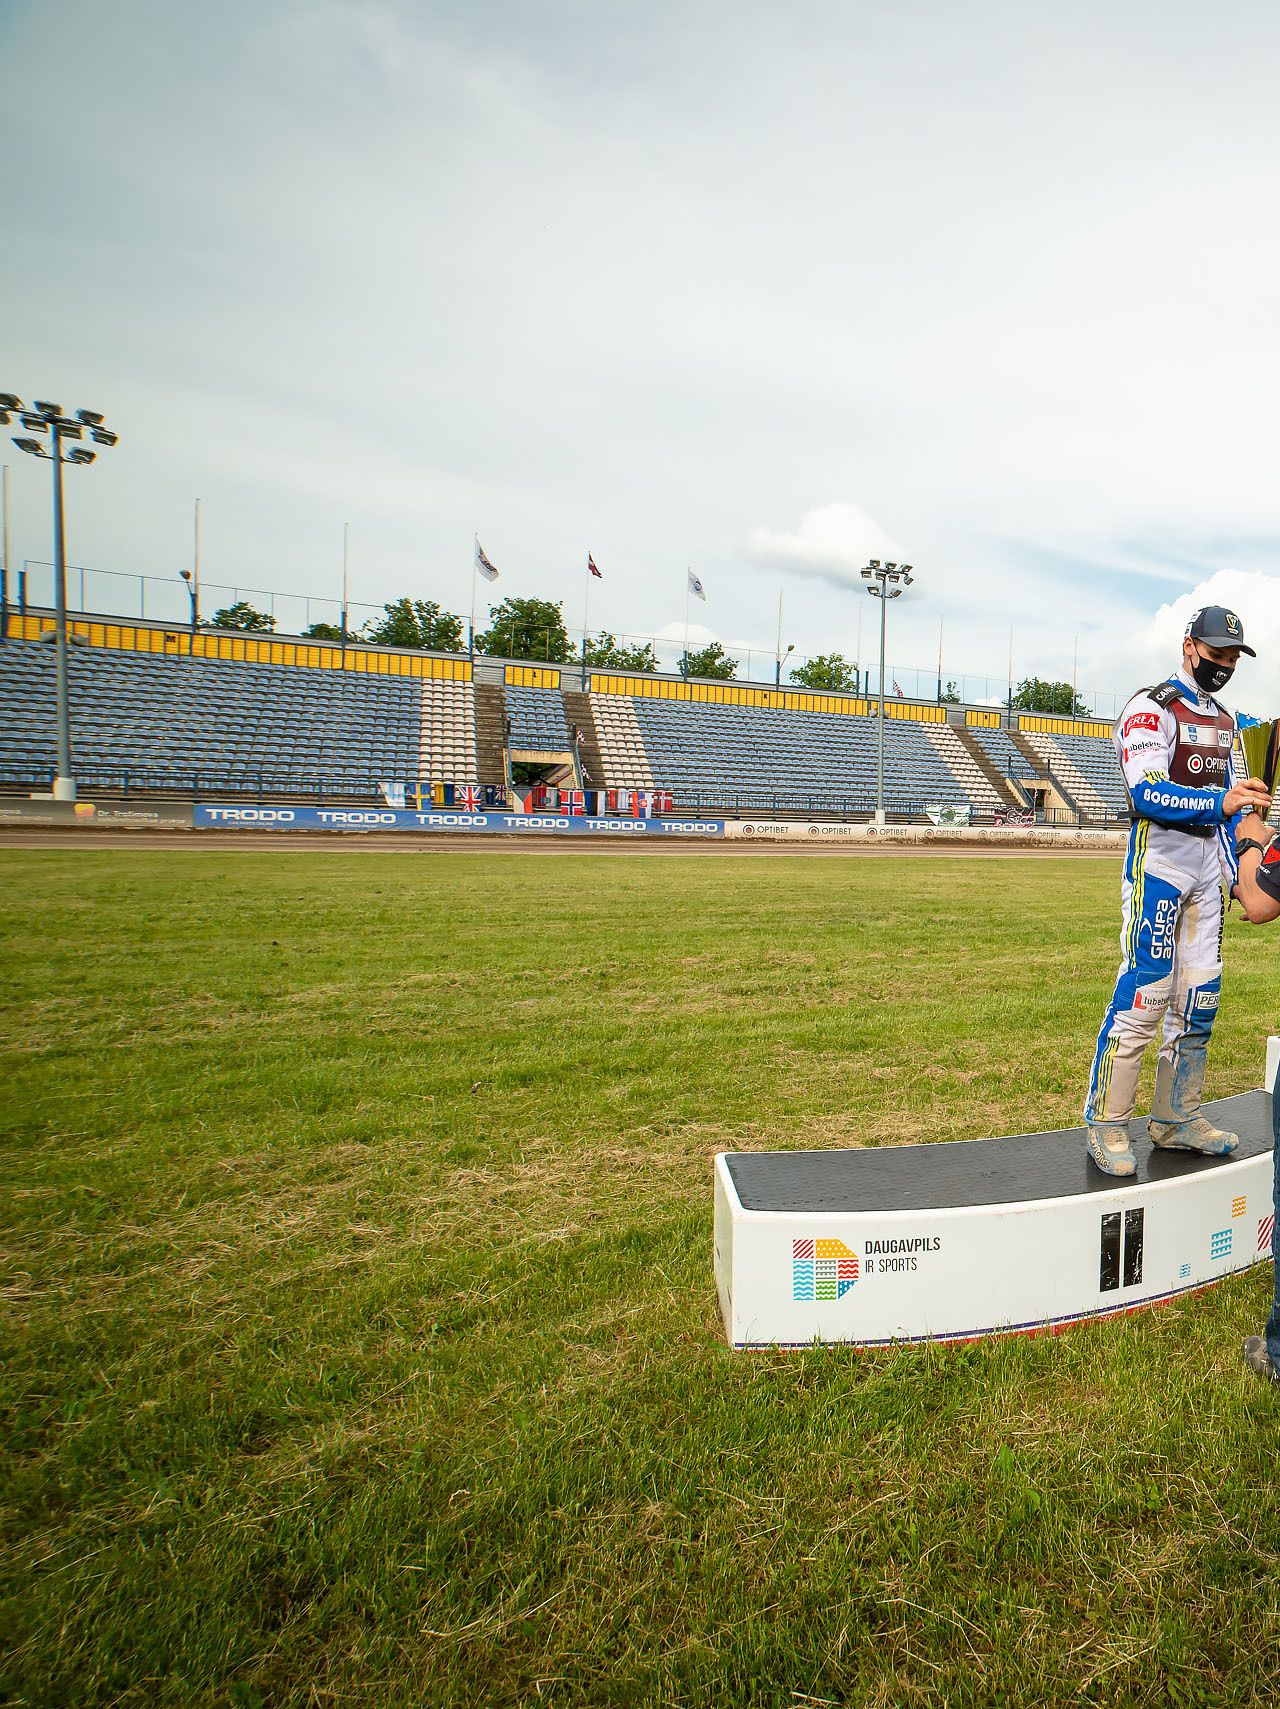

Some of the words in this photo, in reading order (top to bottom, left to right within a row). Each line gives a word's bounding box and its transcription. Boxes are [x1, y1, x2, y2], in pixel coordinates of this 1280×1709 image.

[1143, 788, 1215, 811] BOGDANKA
[204, 808, 296, 822] TRODO
[316, 811, 397, 824] TRODO
[415, 814, 488, 826] TRODO
[503, 816, 570, 829] TRODO
[585, 819, 647, 831] TRODO
[660, 822, 718, 833] TRODO
[757, 825, 789, 834] OPTIBET
[821, 827, 852, 835] OPTIBET
[879, 828, 908, 836] OPTIBET
[935, 830, 963, 838] OPTIBET
[989, 831, 1015, 839] OPTIBET
[865, 1236, 941, 1255] DAUGAVPILS
[865, 1259, 874, 1273] IR
[878, 1257, 918, 1273] SPORTS
